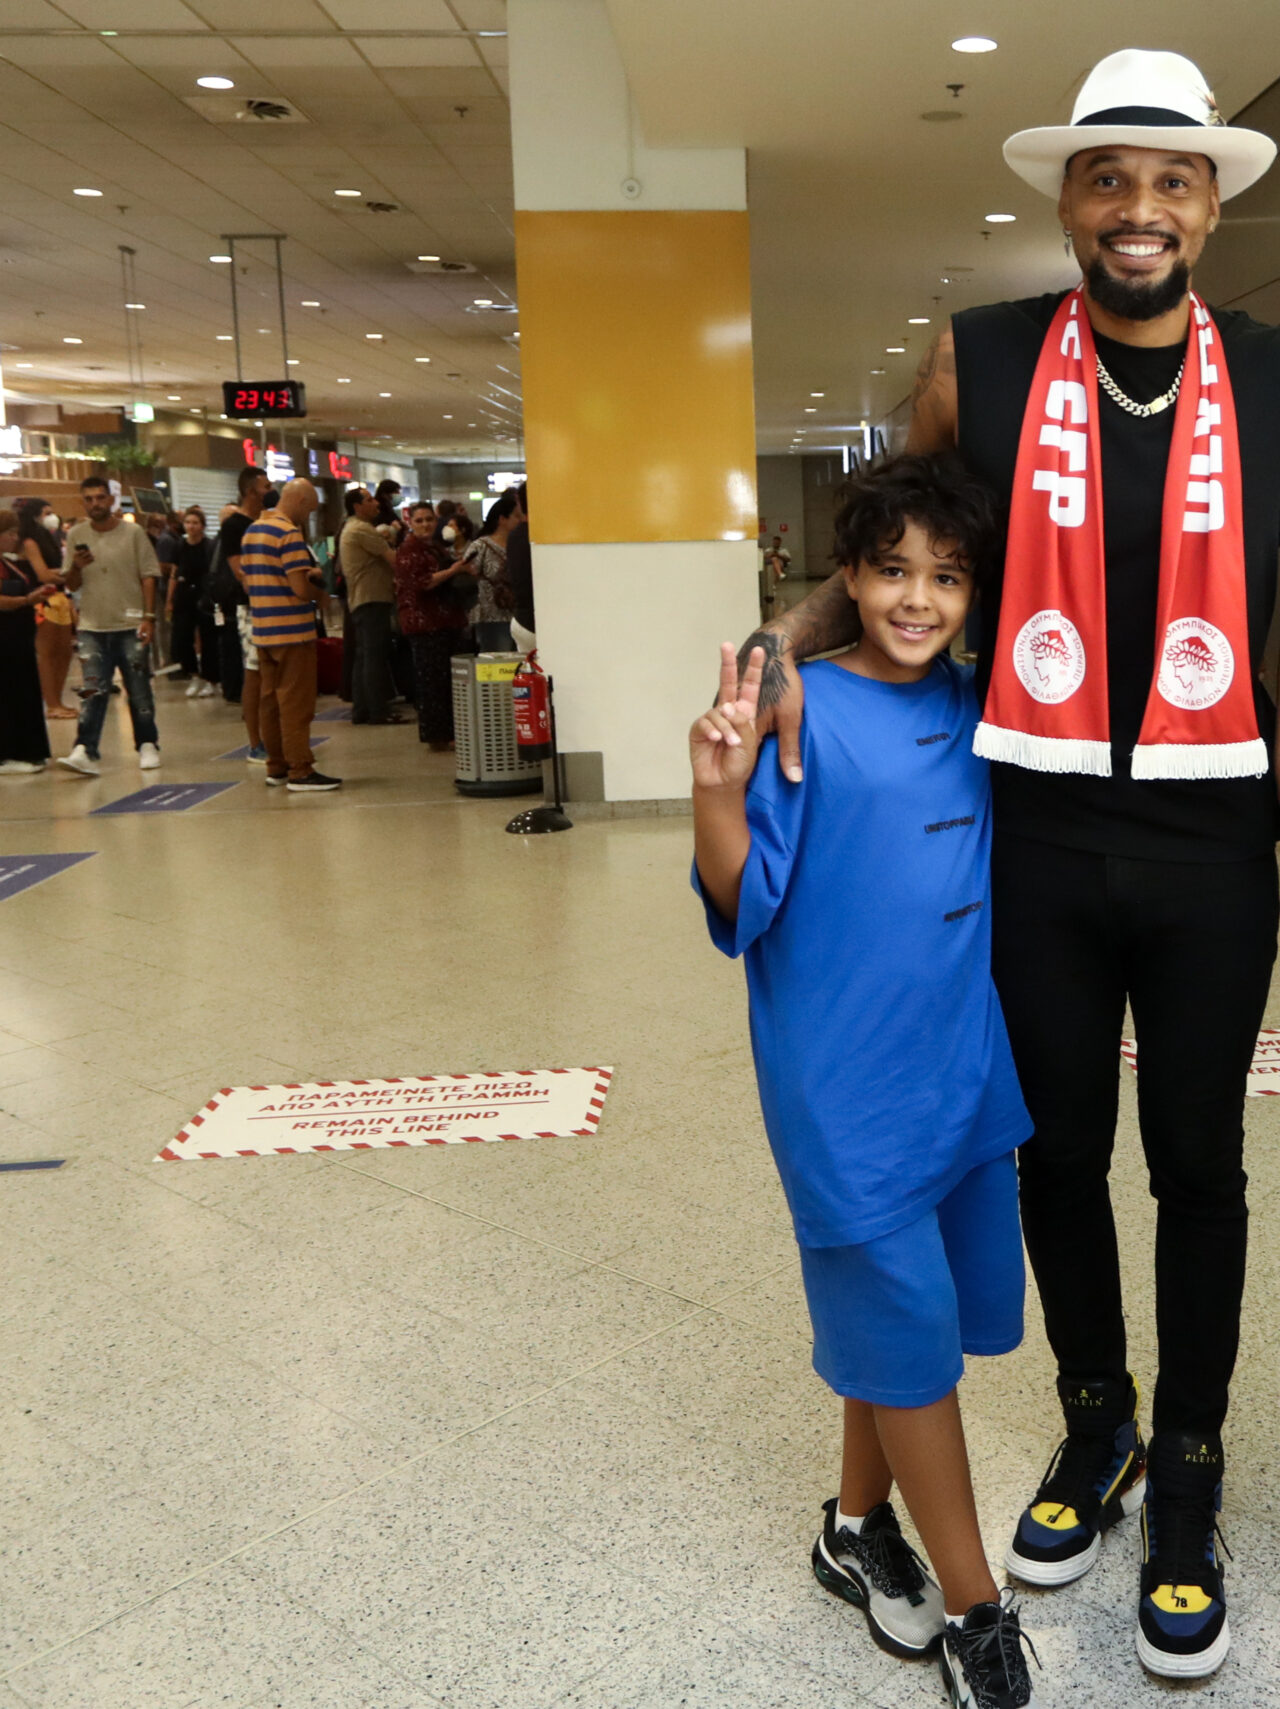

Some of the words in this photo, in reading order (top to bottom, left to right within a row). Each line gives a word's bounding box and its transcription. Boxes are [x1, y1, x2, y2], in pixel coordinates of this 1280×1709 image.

[258, 1103, 315, 1112] ΑΠΟ
[322, 1098, 394, 1108] ΑΥΤΗ
[403, 1096, 435, 1104] ΤΗ
[442, 1089, 550, 1102] ΓΡΑΜΜΗ
[287, 1085, 467, 1101] ΠΑΡΑΜΕΙΝΕΤΕ
[474, 1082, 533, 1091] ΠΙΣΩ
[292, 1117, 395, 1130] REMAIN
[403, 1111, 500, 1124] BEHIND
[326, 1127, 383, 1137] THIS
[392, 1123, 451, 1134] LINE
[1174, 1597, 1188, 1608] 78
